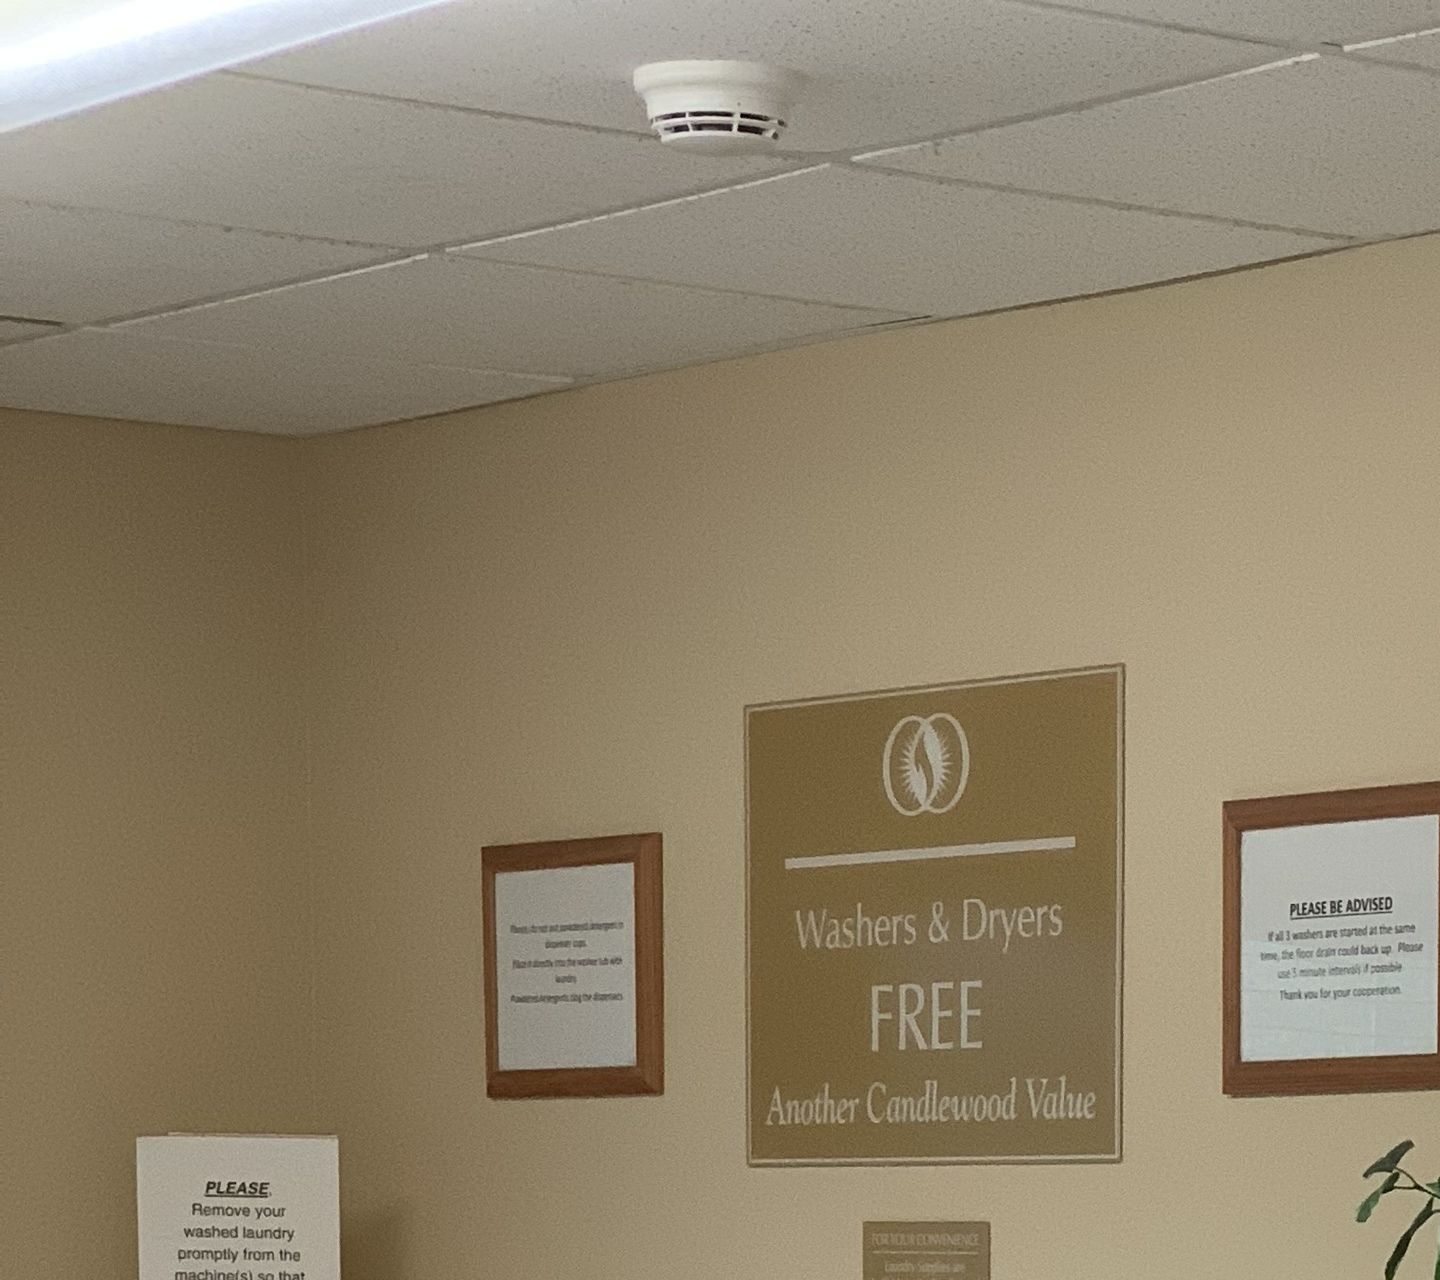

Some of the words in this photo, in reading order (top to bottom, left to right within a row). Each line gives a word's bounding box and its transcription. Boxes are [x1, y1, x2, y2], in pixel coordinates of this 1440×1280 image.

[1290, 901, 1327, 916] PLEASE
[1330, 899, 1343, 914] BE
[1346, 896, 1393, 912] ADVISED
[795, 902, 917, 950] Washers
[928, 900, 949, 944] &
[962, 898, 1064, 954] Dryers
[1292, 929, 1324, 940] washers
[1361, 944, 1379, 955] back
[1320, 988, 1331, 998] for
[869, 979, 983, 1053] FREE
[765, 1084, 860, 1127] Another
[866, 1077, 1016, 1125] Candlewood
[1026, 1075, 1096, 1121] Value
[192, 1203, 251, 1217] Remove
[255, 1205, 287, 1219] your
[184, 1226, 238, 1239] washed
[243, 1226, 295, 1242] laundry
[178, 1249, 239, 1263] promptly
[243, 1248, 275, 1261] from
[279, 1249, 301, 1262] the
